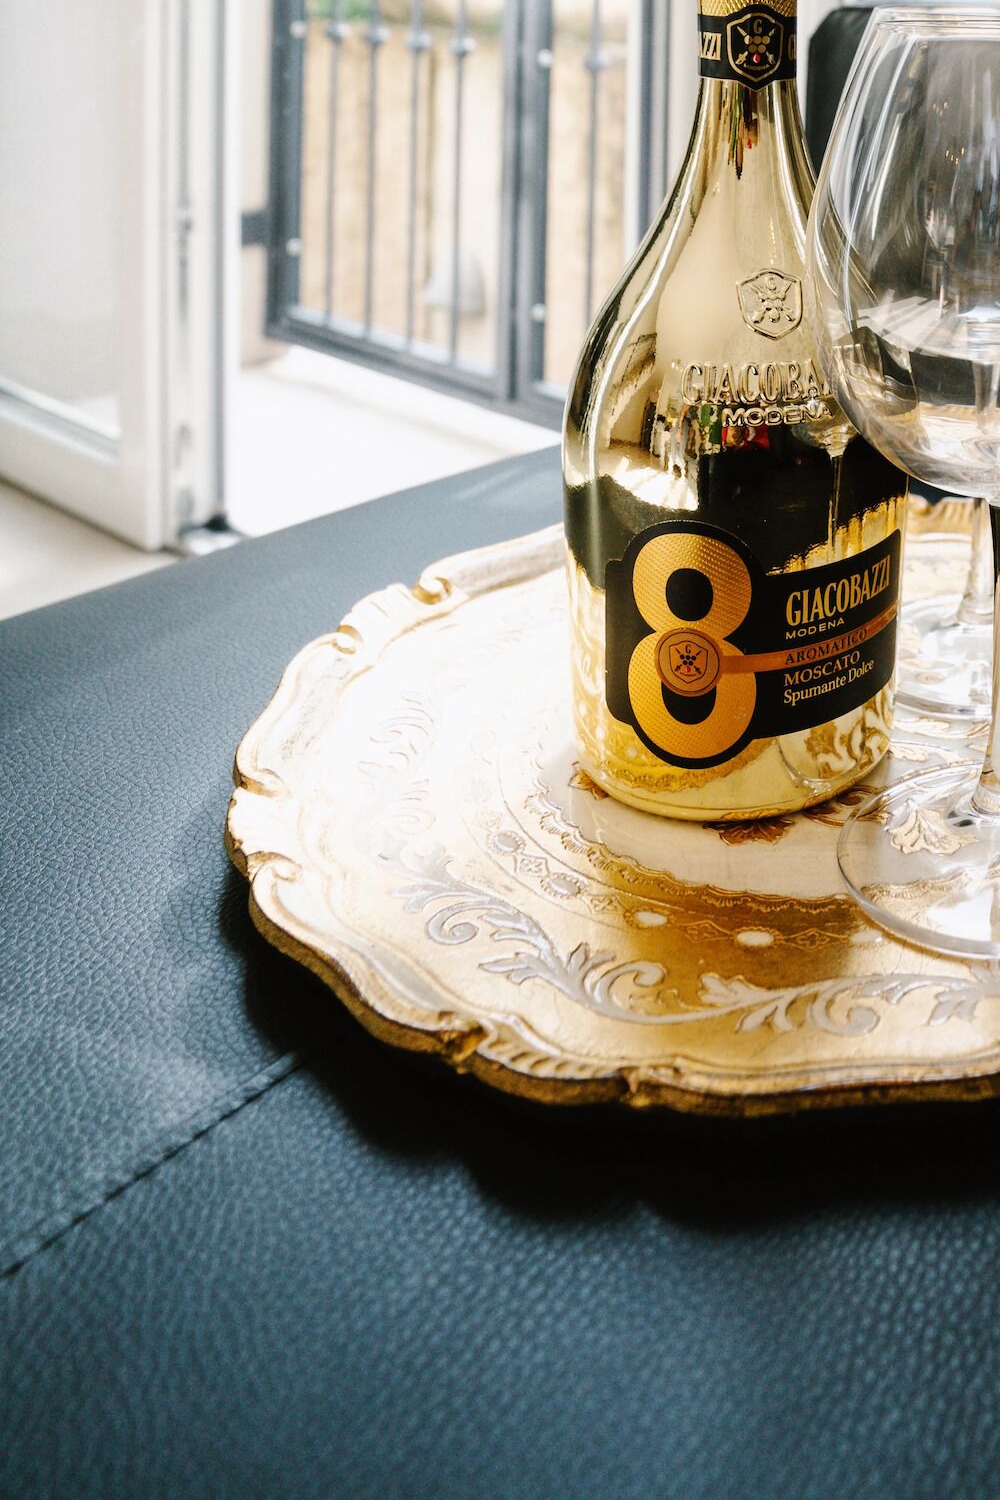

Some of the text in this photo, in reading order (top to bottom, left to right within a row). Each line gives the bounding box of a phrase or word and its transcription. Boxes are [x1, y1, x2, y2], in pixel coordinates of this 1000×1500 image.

[753, 19, 763, 34] G
[681, 358, 833, 406] GIACOBA
[722, 401, 834, 428] MODENA
[785, 554, 892, 627] GIACOBAZZI
[627, 532, 757, 759] 8
[784, 626, 868, 666] AROMATICO
[785, 617, 846, 640] MODENA
[783, 650, 861, 688] MOSCATO
[783, 658, 876, 707] Spumante Dolce
